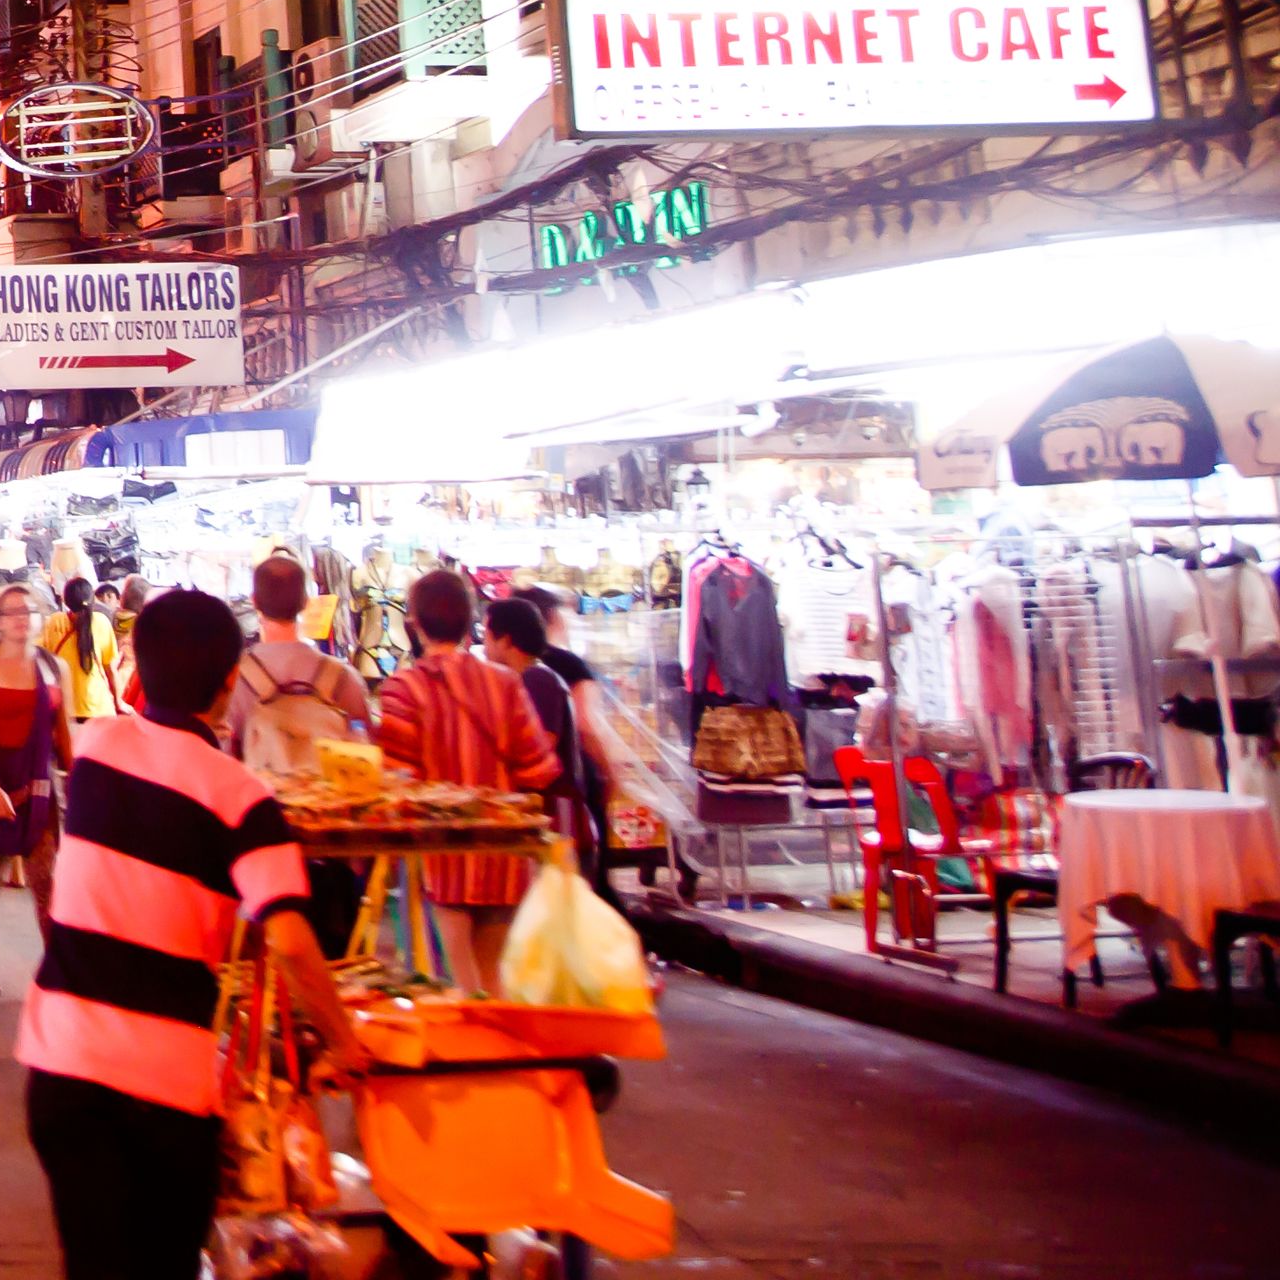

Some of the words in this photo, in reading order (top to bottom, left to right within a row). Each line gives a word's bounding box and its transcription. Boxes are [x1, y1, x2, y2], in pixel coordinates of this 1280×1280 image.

[592, 8, 920, 69] INTERNET
[949, 5, 1118, 61] CAFE
[65, 273, 131, 313] KONG
[135, 271, 236, 312] TAILORS
[54, 322, 65, 342] &
[70, 321, 109, 341] GENT
[115, 320, 178, 341] CUSTOM
[182, 319, 239, 340] TAILOR
